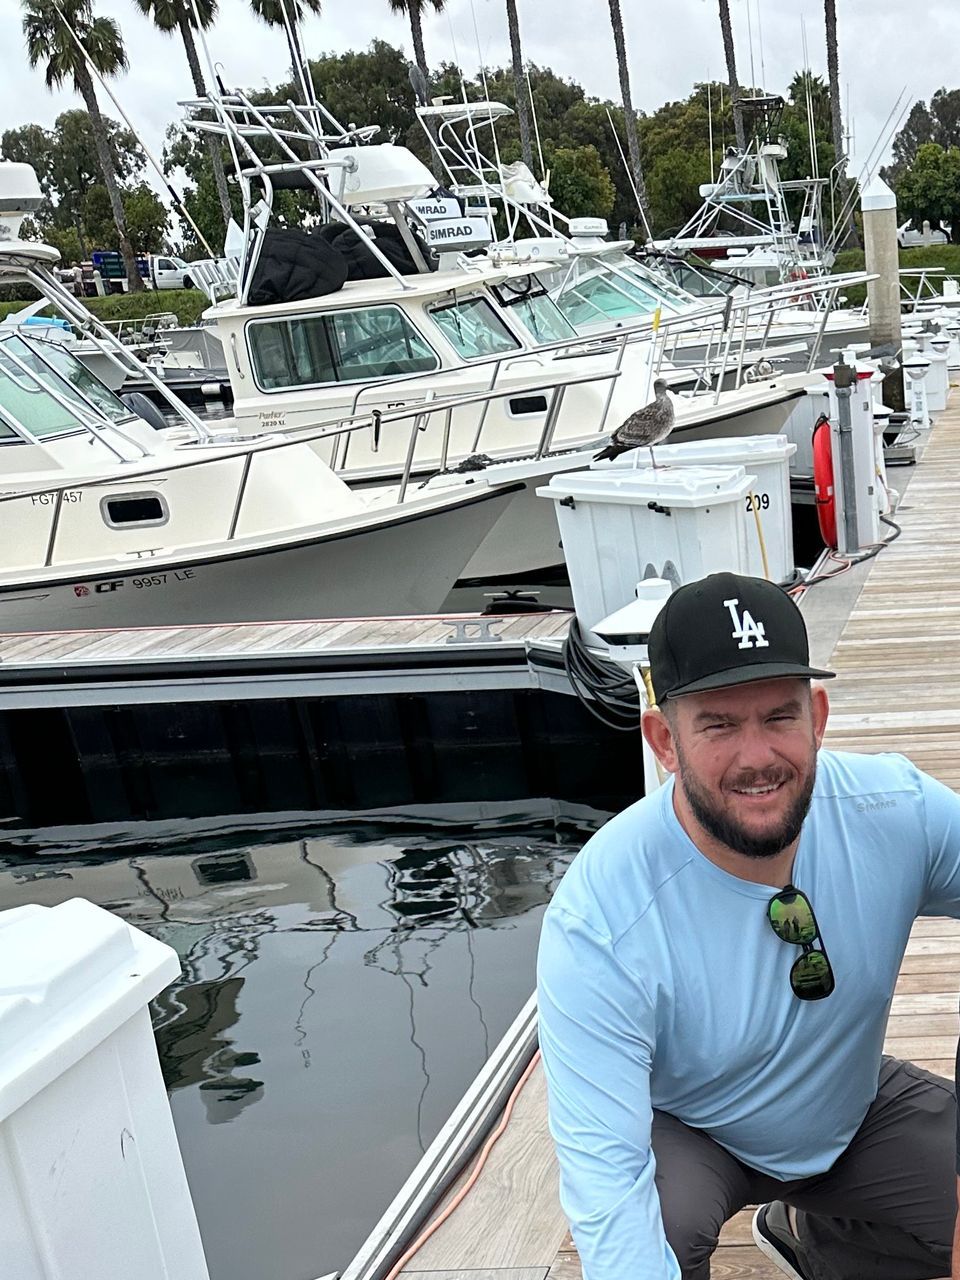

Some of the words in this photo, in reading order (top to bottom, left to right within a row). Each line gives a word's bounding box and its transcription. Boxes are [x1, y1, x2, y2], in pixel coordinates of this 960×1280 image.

[416, 205, 447, 214] MRAD
[430, 226, 473, 240] SIMRAD
[31, 491, 83, 506] FG7457
[95, 580, 124, 593] CF
[132, 574, 168, 589] 9957
[174, 569, 196, 581] LE
[723, 598, 770, 649] LA
